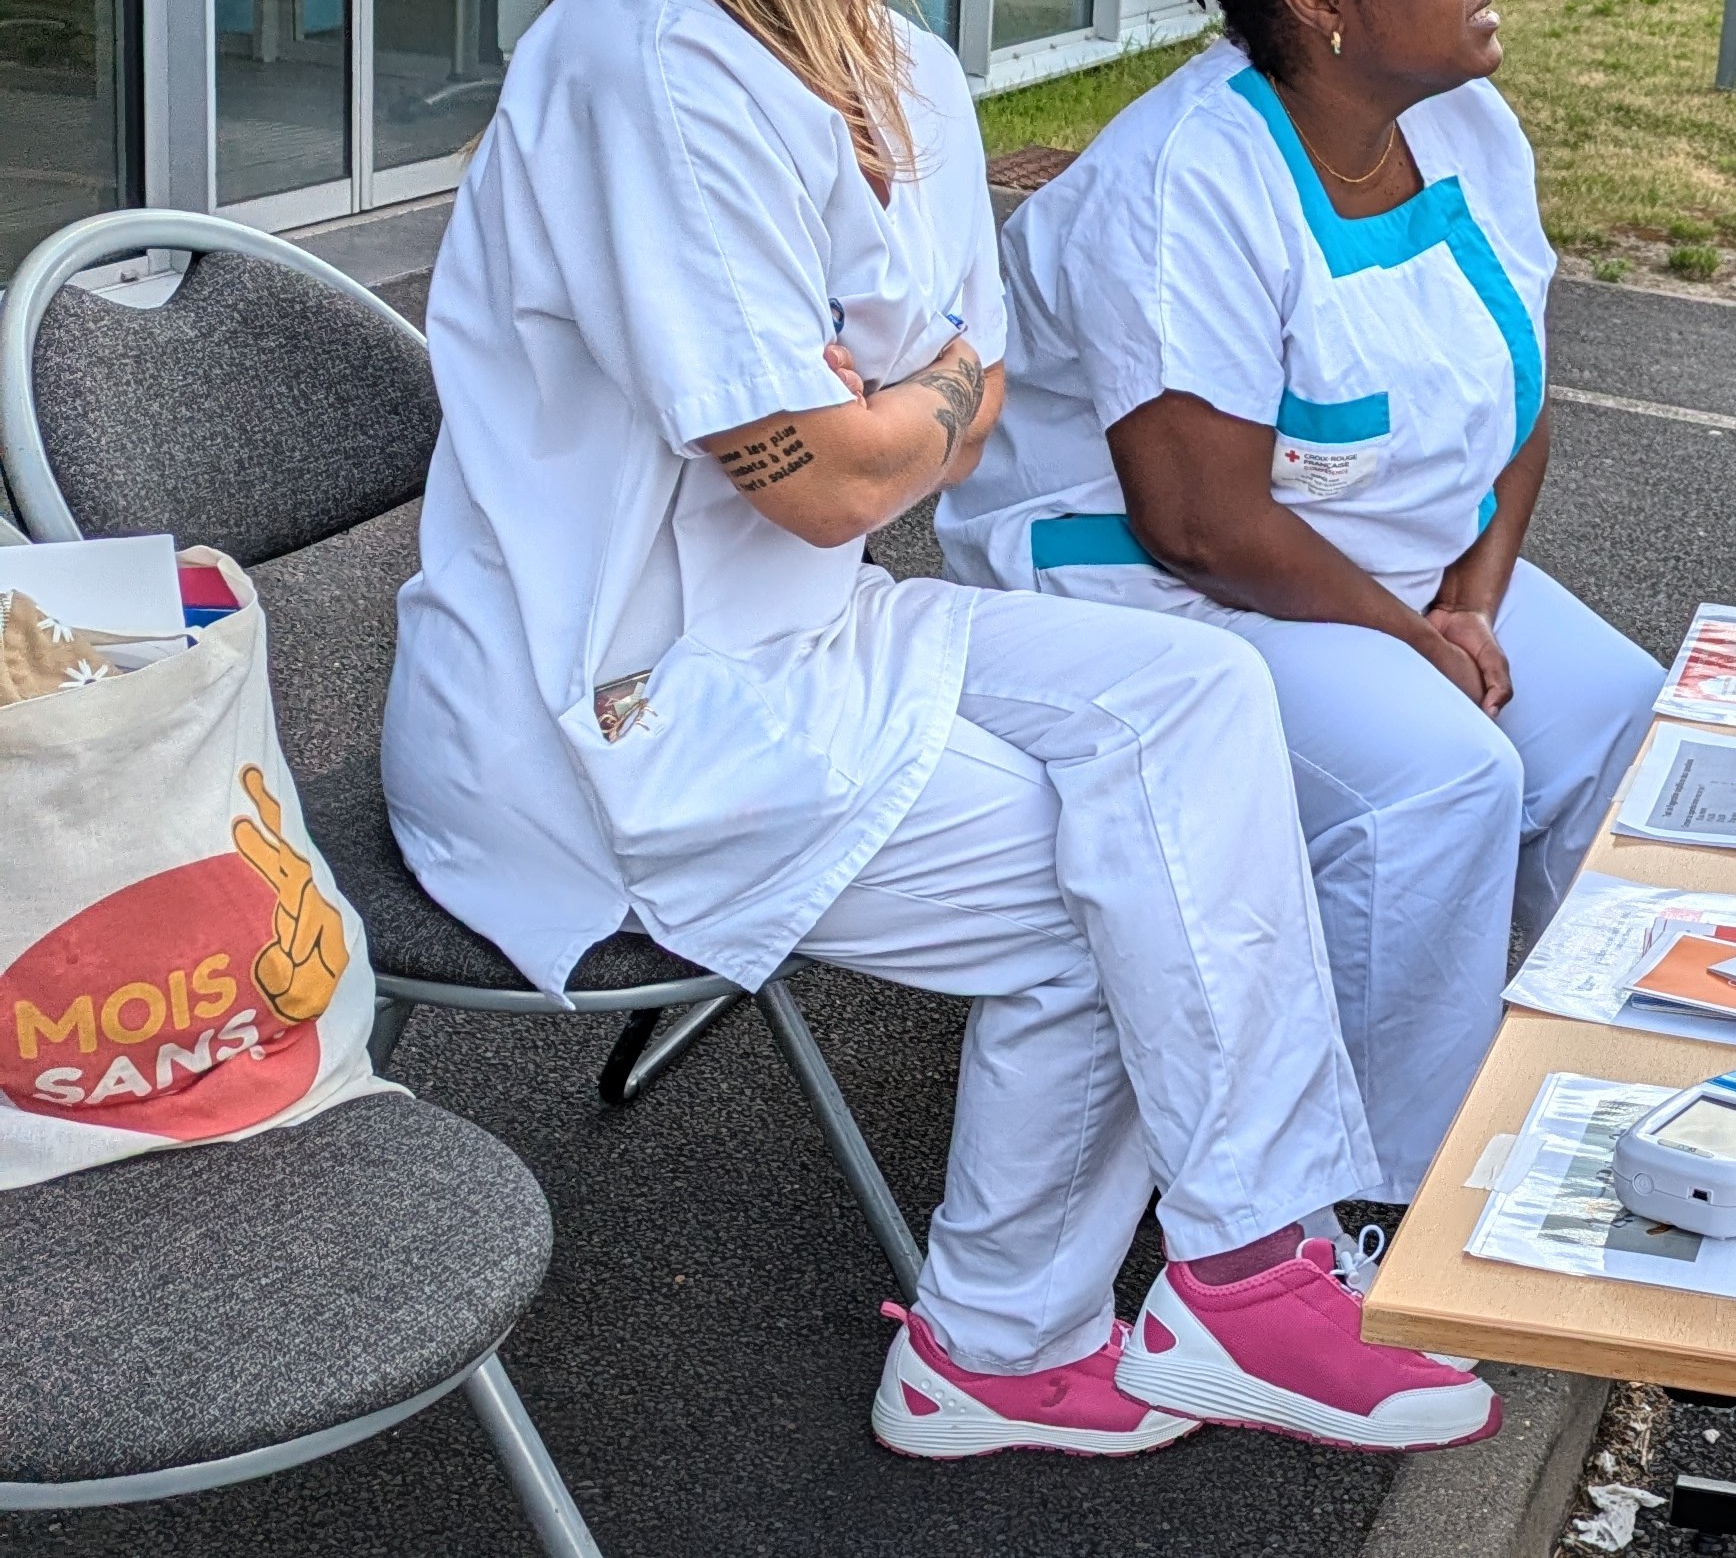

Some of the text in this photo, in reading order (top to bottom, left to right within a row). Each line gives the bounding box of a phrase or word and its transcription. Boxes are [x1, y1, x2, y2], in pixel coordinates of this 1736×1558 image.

[770, 425, 797, 451] plus
[12, 952, 239, 1061] MOIS
[34, 1008, 260, 1106] SANS
